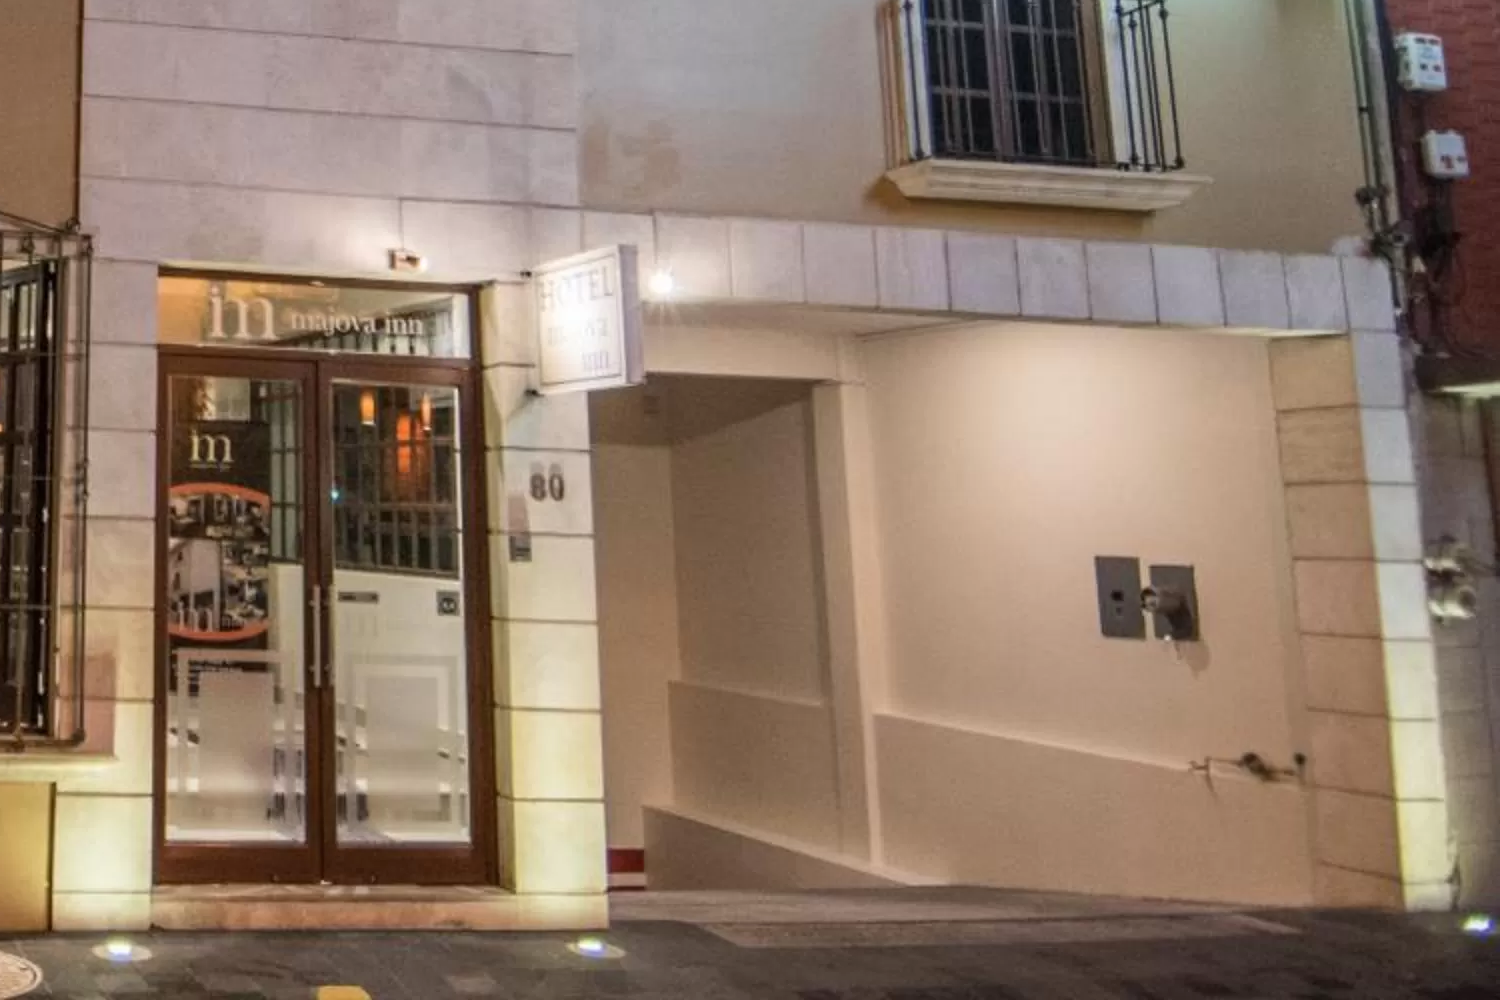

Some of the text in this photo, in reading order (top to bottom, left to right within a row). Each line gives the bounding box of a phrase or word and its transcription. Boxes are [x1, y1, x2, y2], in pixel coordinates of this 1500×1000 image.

[291, 302, 377, 337] majova
[385, 310, 424, 336] inn
[530, 473, 565, 502] 80
